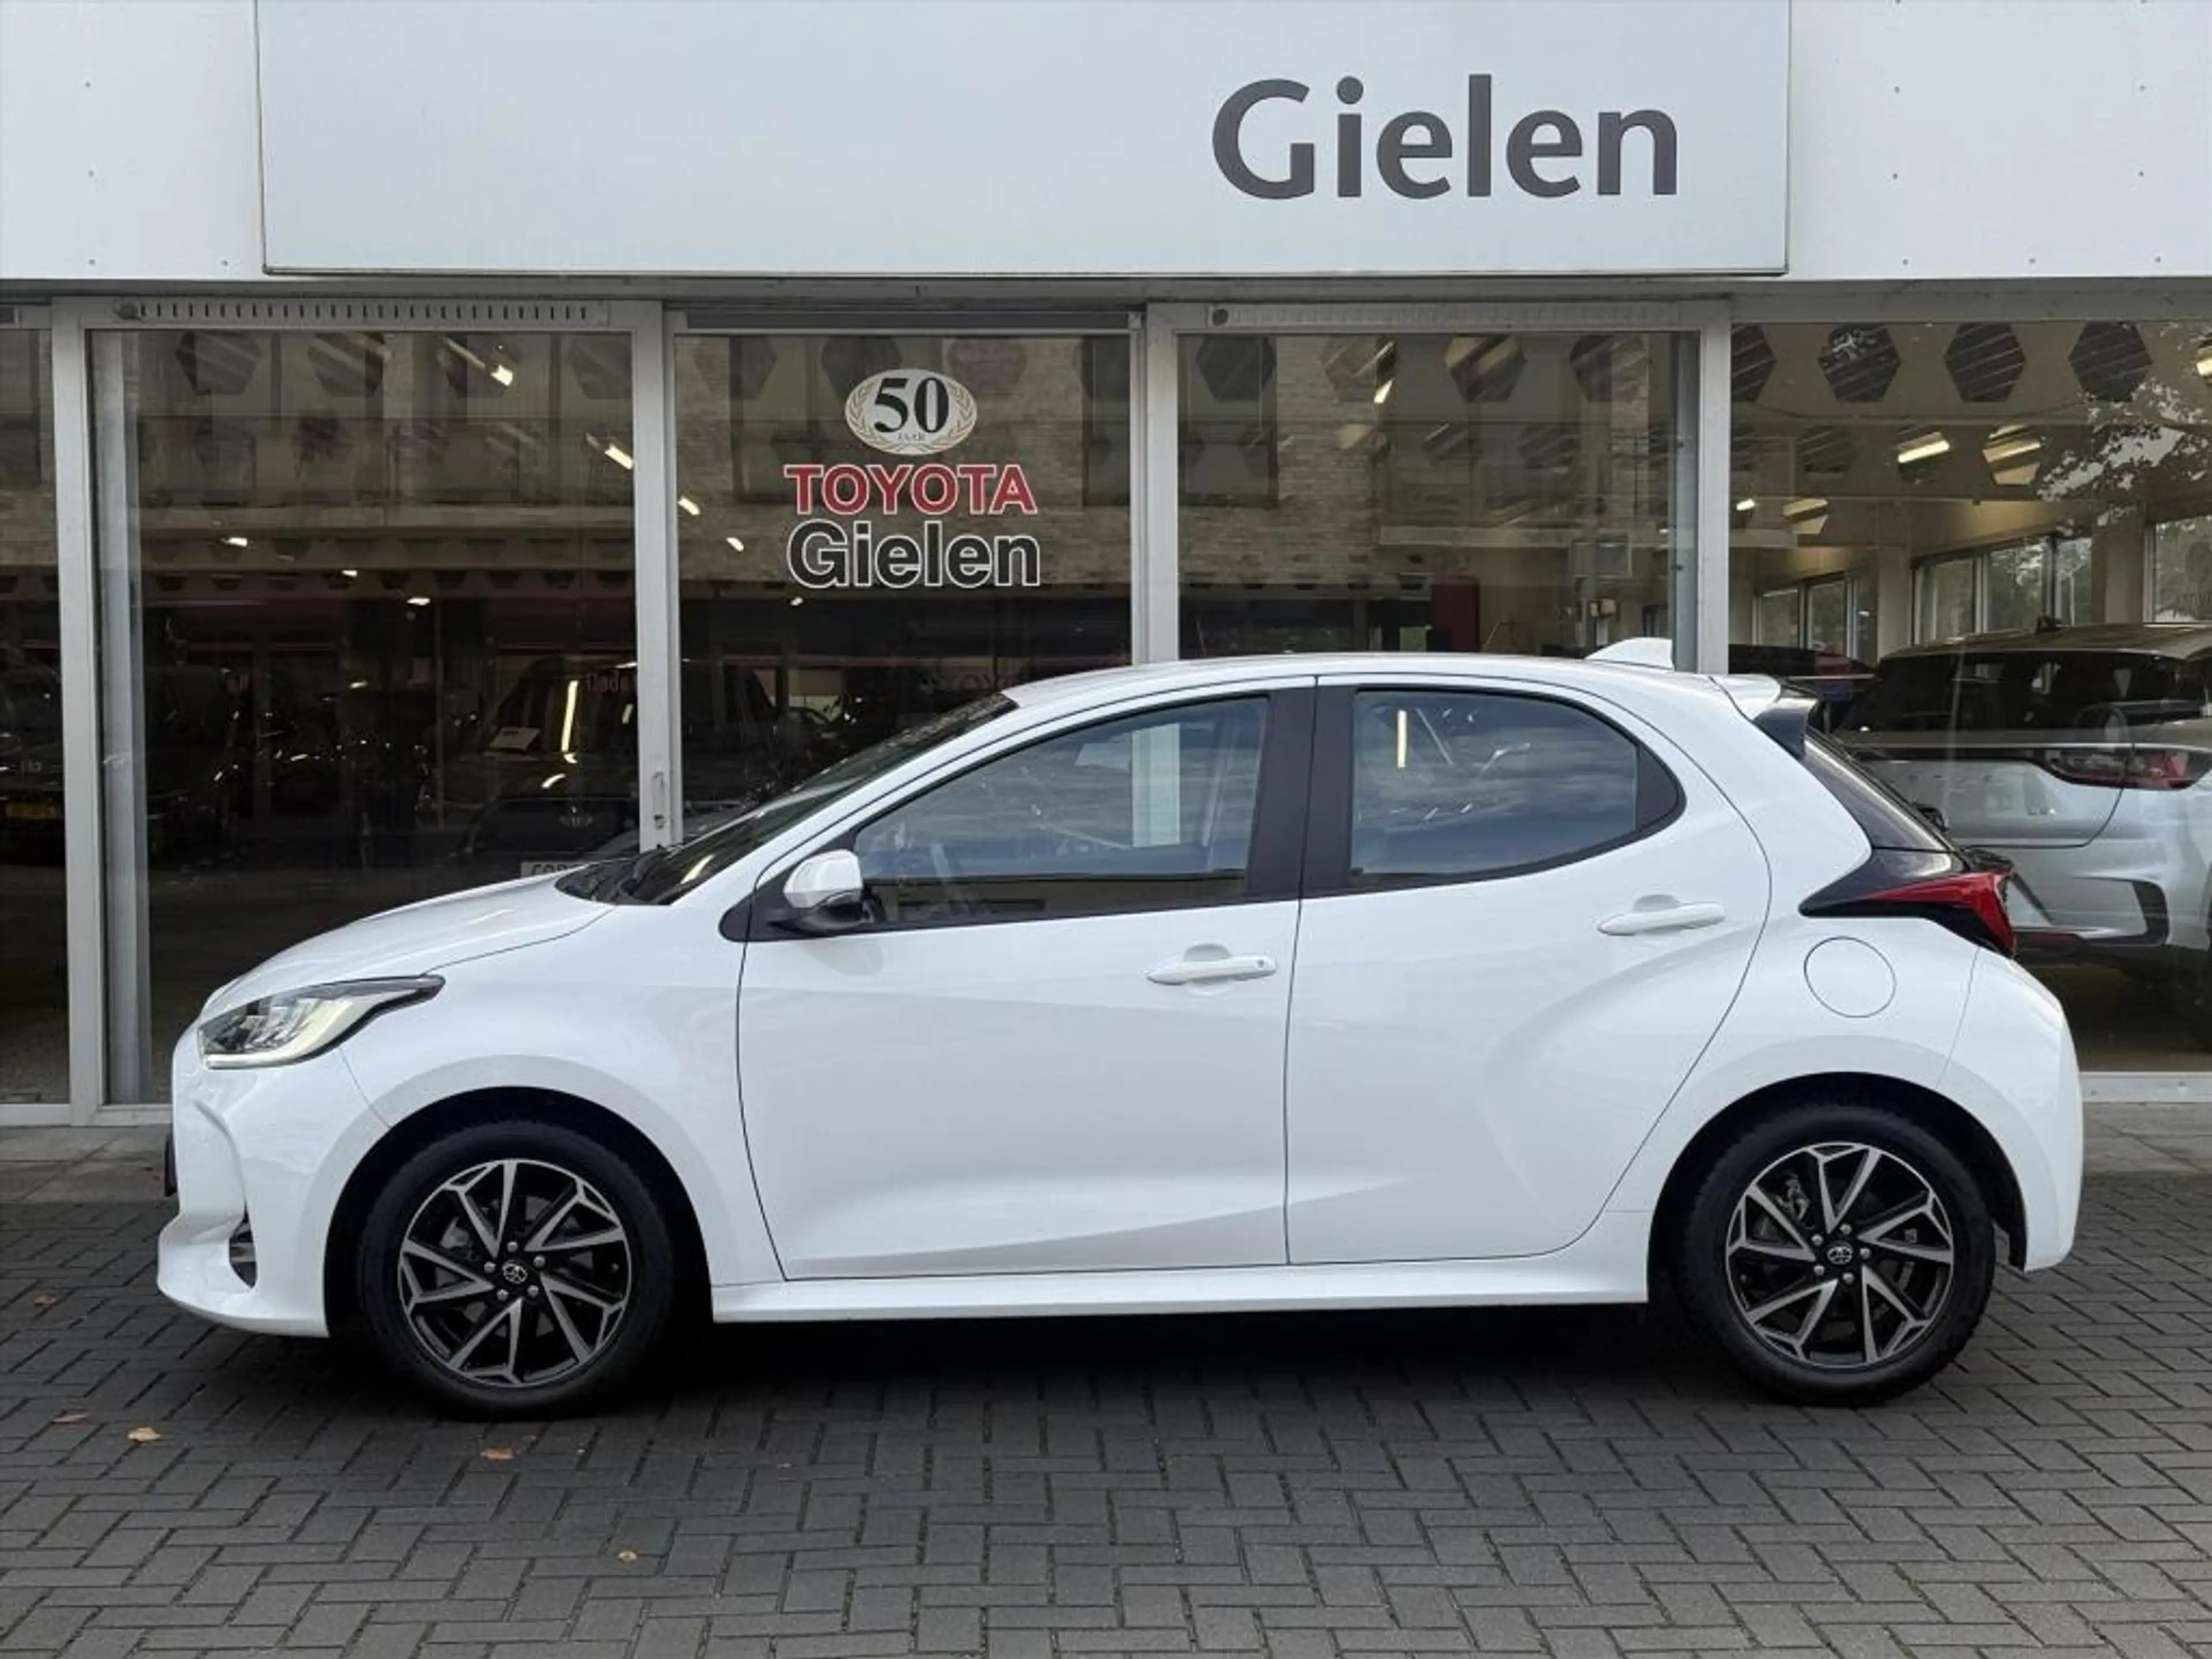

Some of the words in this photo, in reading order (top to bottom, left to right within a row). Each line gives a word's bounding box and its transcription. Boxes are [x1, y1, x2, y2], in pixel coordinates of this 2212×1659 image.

[1212, 74, 1677, 199] Gielen
[873, 377, 950, 433] 50
[784, 464, 1038, 515] TOYOTA
[786, 519, 1040, 588] Gielen
